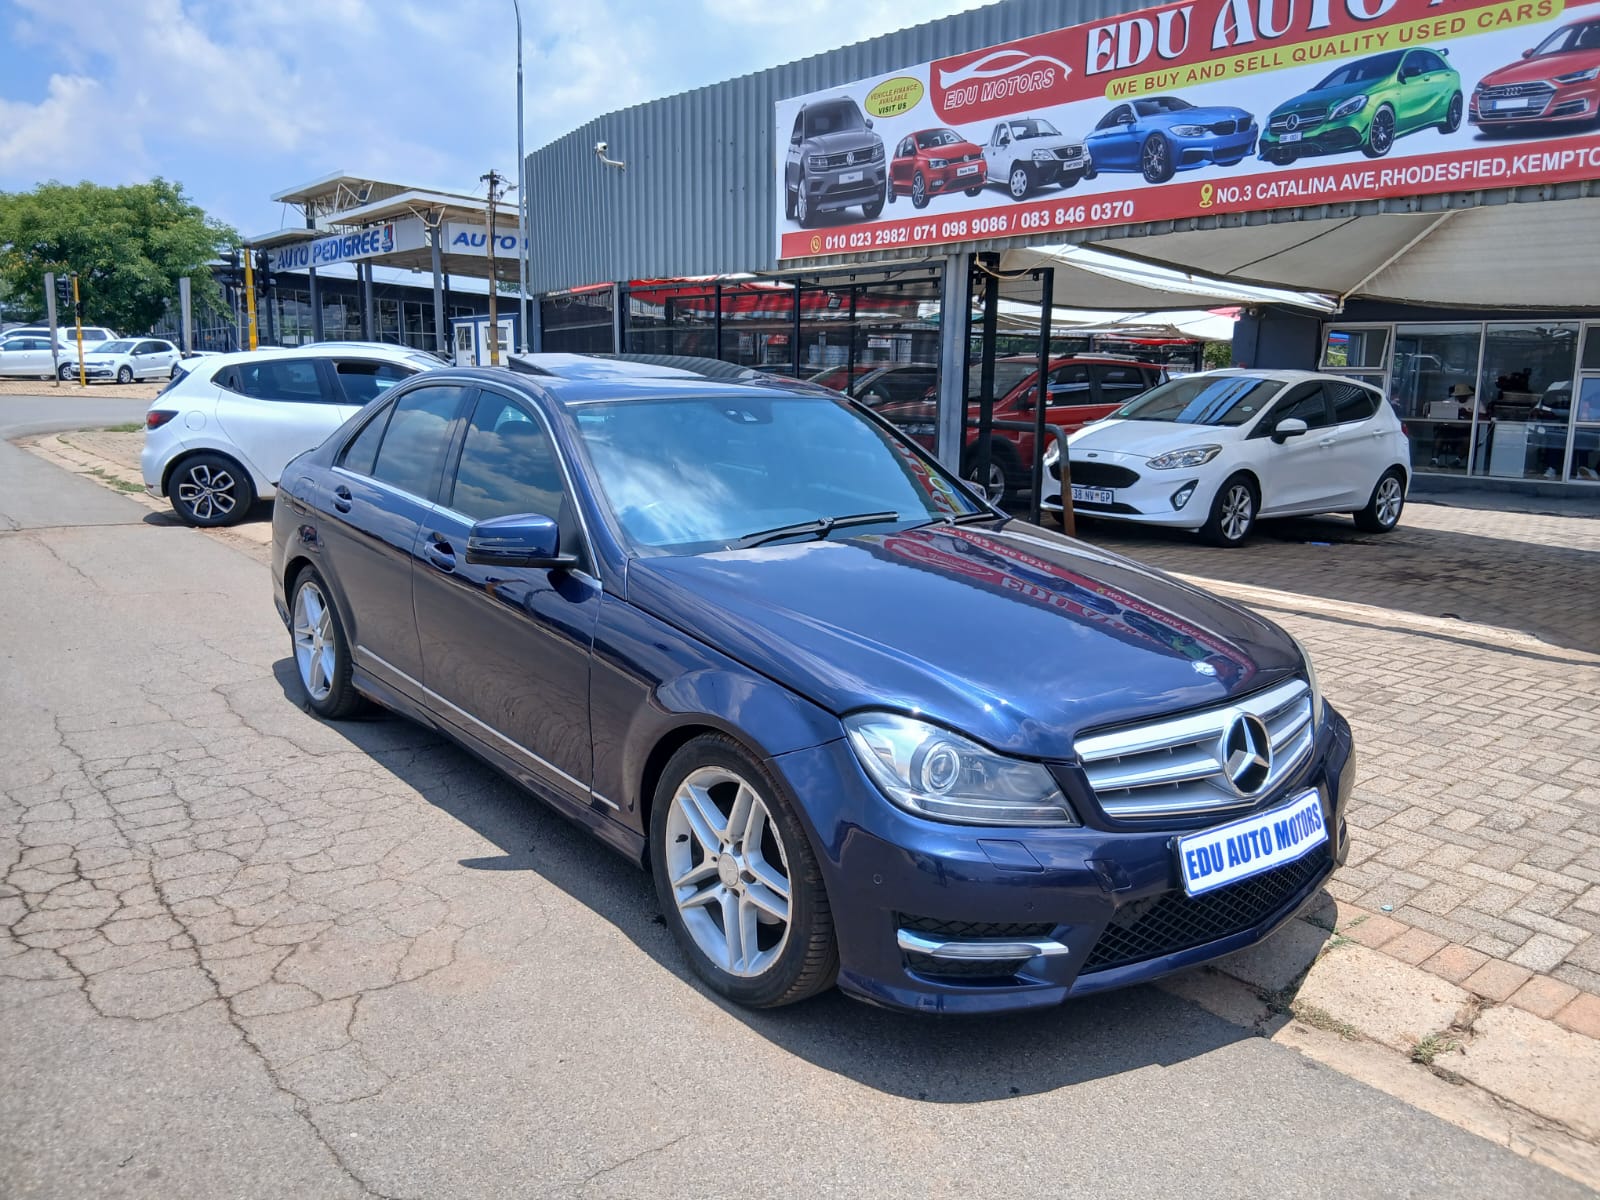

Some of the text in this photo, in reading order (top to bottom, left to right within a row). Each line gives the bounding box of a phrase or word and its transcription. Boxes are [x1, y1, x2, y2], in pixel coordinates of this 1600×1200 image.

[1086, 6, 1195, 76] EDU
[1112, 0, 1553, 96] WE BUY AND SELL QUALITY USED CARS
[870, 89, 893, 100] VEHICLE
[878, 102, 907, 114] VISIT US
[943, 67, 1055, 110] EDU MOTORS
[1216, 185, 1252, 204] NO.3
[1256, 177, 1336, 200] CATALINA
[825, 235, 848, 250] 010
[850, 232, 872, 247] 023
[913, 225, 937, 240] 071
[941, 221, 967, 236] 098
[971, 215, 1007, 234] 9086
[1020, 210, 1051, 228] 083
[1055, 205, 1085, 225] 846
[1091, 200, 1134, 221] 0370
[277, 229, 380, 270] AUTO PEDIGREE
[1100, 491, 1110, 502] GP
[1185, 802, 1322, 880] EDU AUTO MOTORS
